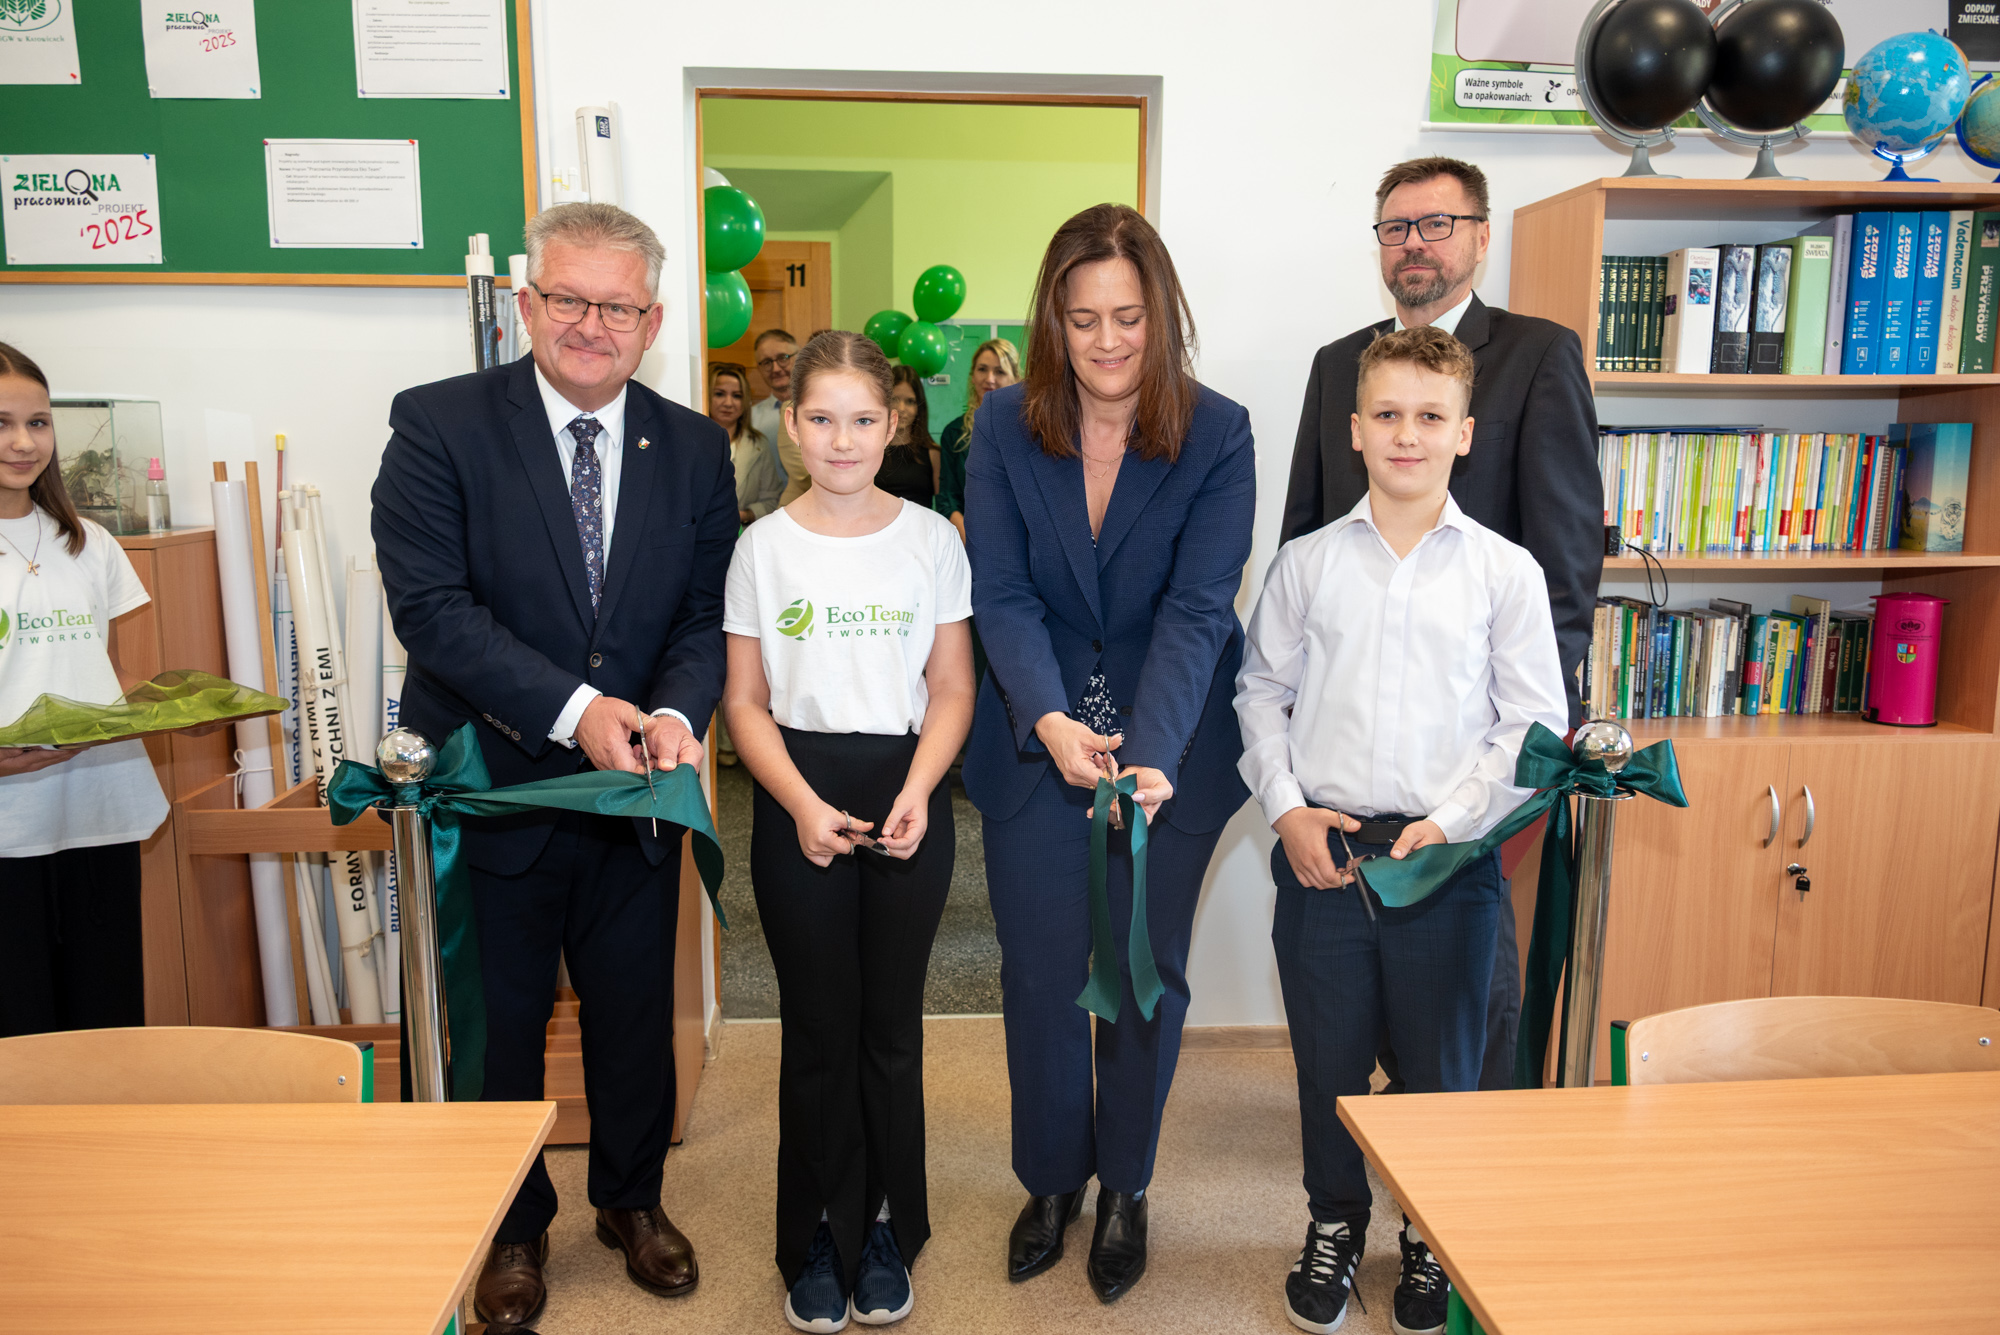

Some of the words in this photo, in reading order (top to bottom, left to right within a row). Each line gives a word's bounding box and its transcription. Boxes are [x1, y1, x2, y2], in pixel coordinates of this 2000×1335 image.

[1958, 14, 1999, 24] ZMIESZANE
[1965, 4, 1995, 13] ODPADY
[1465, 78, 1490, 87] Ważne
[1492, 79, 1524, 90] symbole
[1463, 91, 1473, 100] na
[1475, 92, 1532, 102] opakowaniach:
[13, 171, 121, 195] ZIELONA
[14, 197, 91, 210] pracownia
[1860, 237, 1872, 279] ŚWIAT
[1868, 227, 1880, 278] WIEDZY
[1893, 236, 1905, 279] ŚWIAT
[1900, 227, 1912, 278] WIEDZY
[1923, 236, 1935, 278] ŚWIAT
[1930, 226, 1942, 278] WIEDZY
[1951, 220, 1970, 290] Vademecum
[786, 264, 805, 287] 11
[1609, 268, 1617, 282] ABC
[1620, 268, 1628, 282] ABC
[1644, 269, 1652, 282] ABC
[1657, 269, 1665, 282] ABC
[1975, 265, 1990, 343] PRZYRODY
[825, 605, 914, 624] EcoTeam
[1768, 641, 1777, 665] ATLAS
[1828, 652, 1836, 670] Owady
[1843, 640, 1851, 672] ZWIERZĘTA
[1754, 650, 1762, 685] BIOLOGICZNY
[305, 701, 320, 741] NIMI
